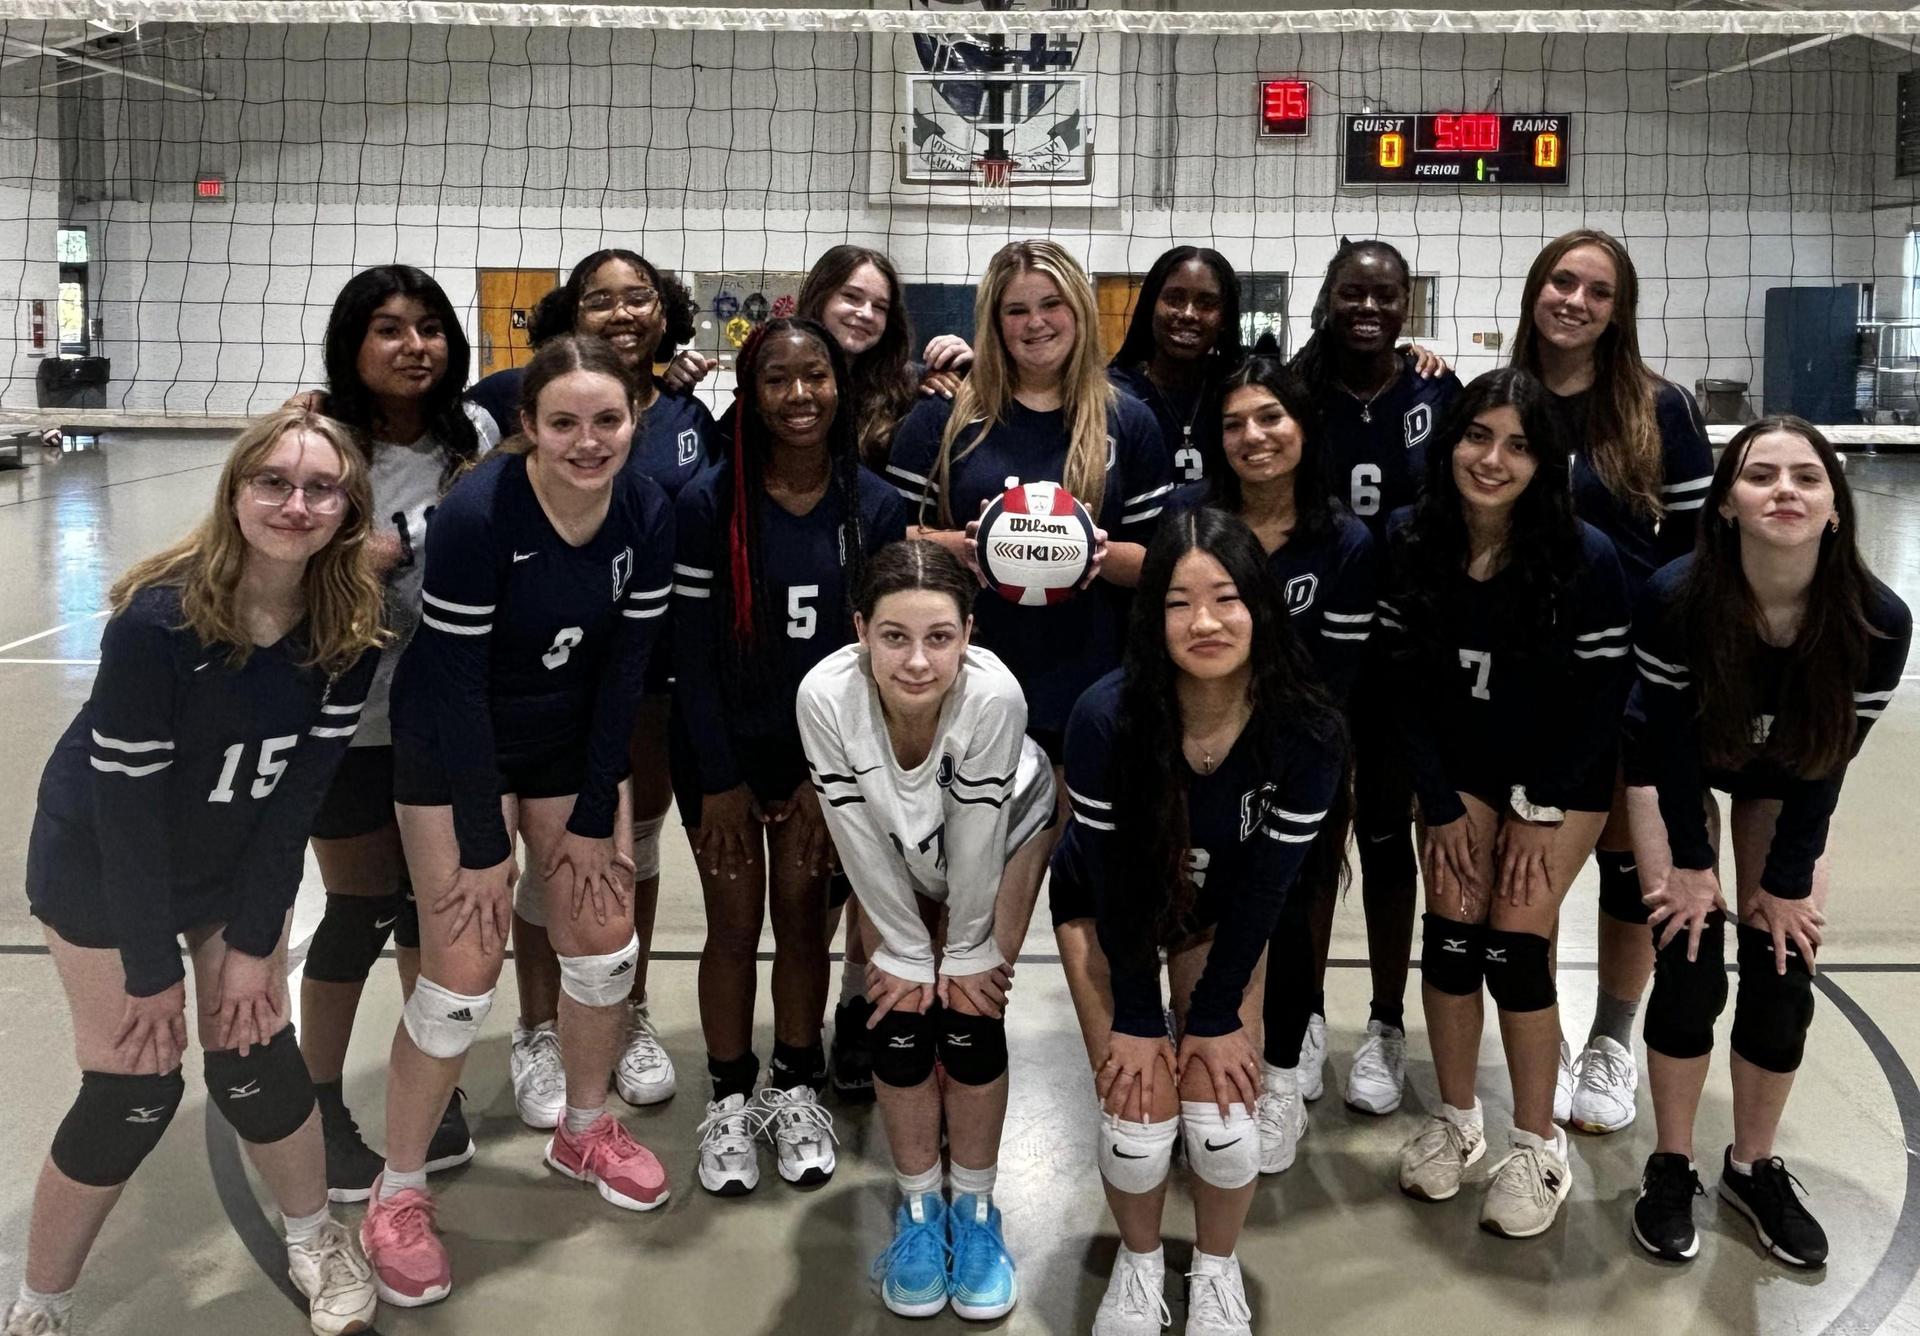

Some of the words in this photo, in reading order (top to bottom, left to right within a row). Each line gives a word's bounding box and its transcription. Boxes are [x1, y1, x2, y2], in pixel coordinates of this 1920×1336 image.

[1264, 87, 1307, 118] 35
[1353, 119, 1405, 132] GUEST
[1512, 119, 1559, 132] RAMS
[1380, 133, 1402, 168] 0
[1535, 133, 1558, 168] 0
[1415, 164, 1460, 175] PERIOD
[1403, 402, 1433, 449] D
[678, 427, 699, 467] D
[1350, 463, 1382, 516] 6
[1009, 517, 1069, 535] Wilson
[786, 584, 819, 640] 5
[1283, 572, 1319, 616] D
[1458, 648, 1492, 701] 7
[207, 734, 299, 803] 15
